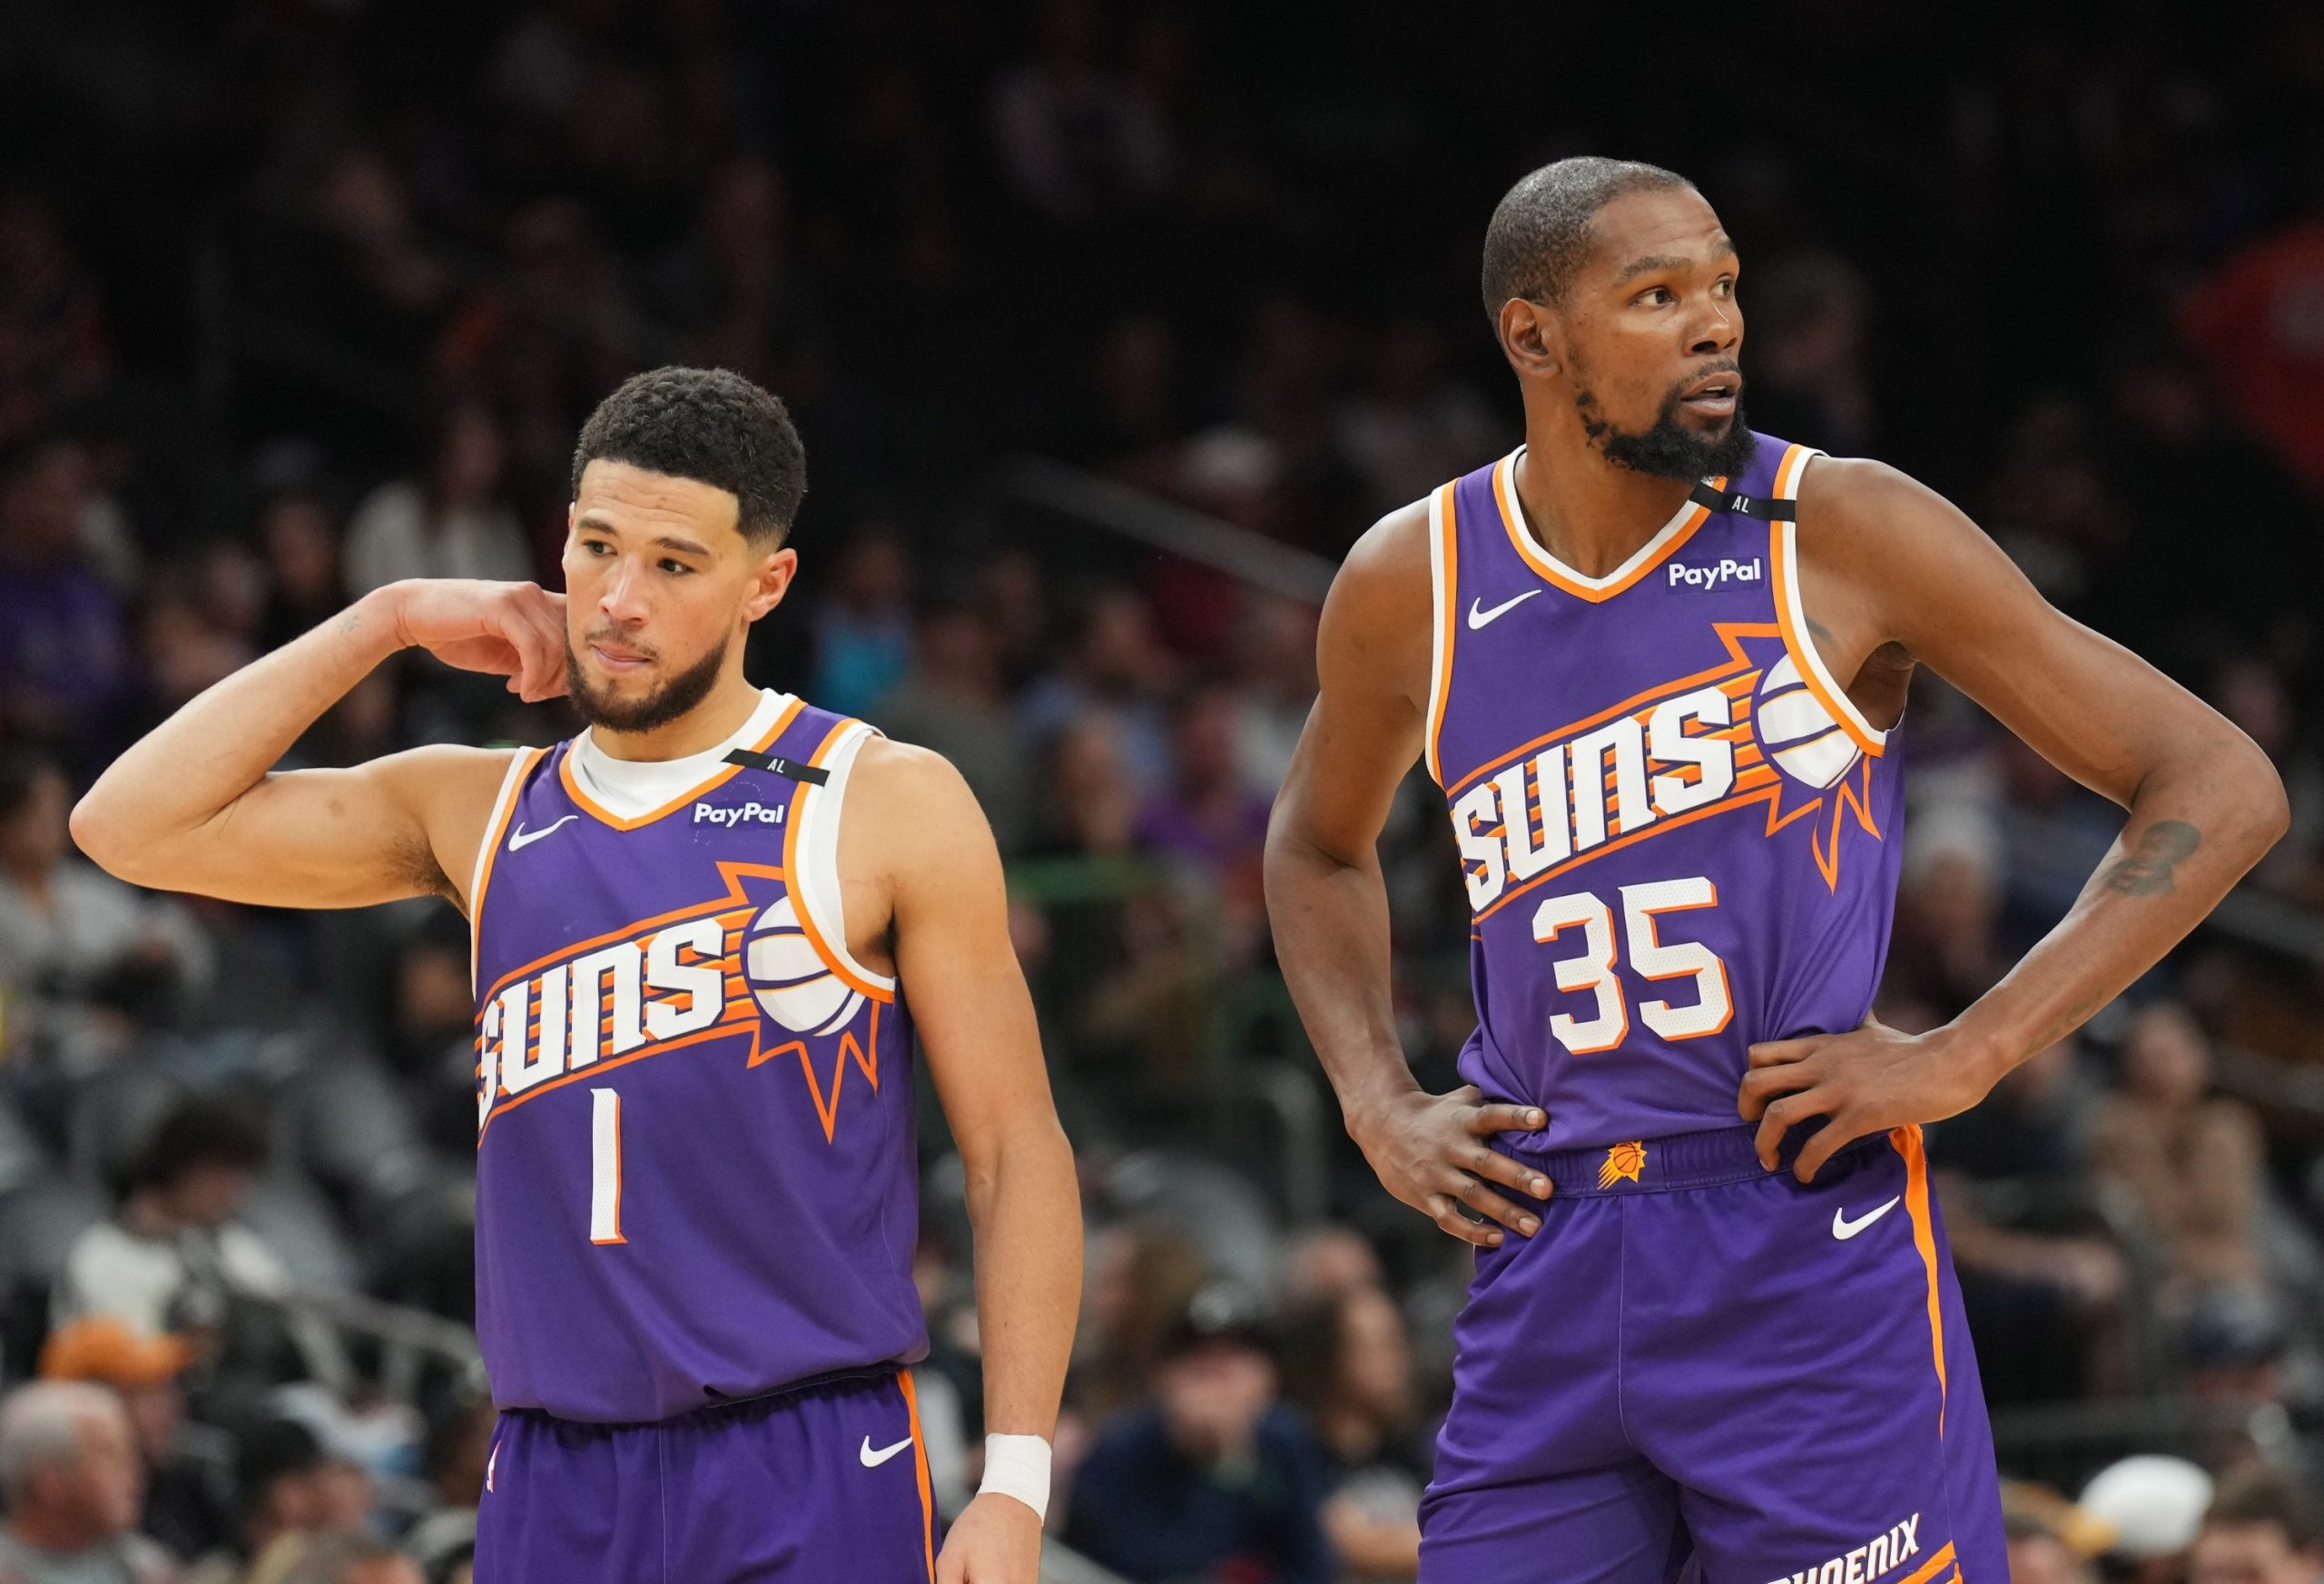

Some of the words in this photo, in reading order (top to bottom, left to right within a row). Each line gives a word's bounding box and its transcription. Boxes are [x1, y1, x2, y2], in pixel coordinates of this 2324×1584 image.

[1731, 495, 1749, 514] AL
[1669, 557, 1761, 590] PayPal
[766, 758, 784, 773] AL
[694, 802, 784, 828] PayPal
[1452, 686, 1734, 912] SUNS
[1531, 876, 1734, 1056] 35
[590, 1087, 627, 1245] 1
